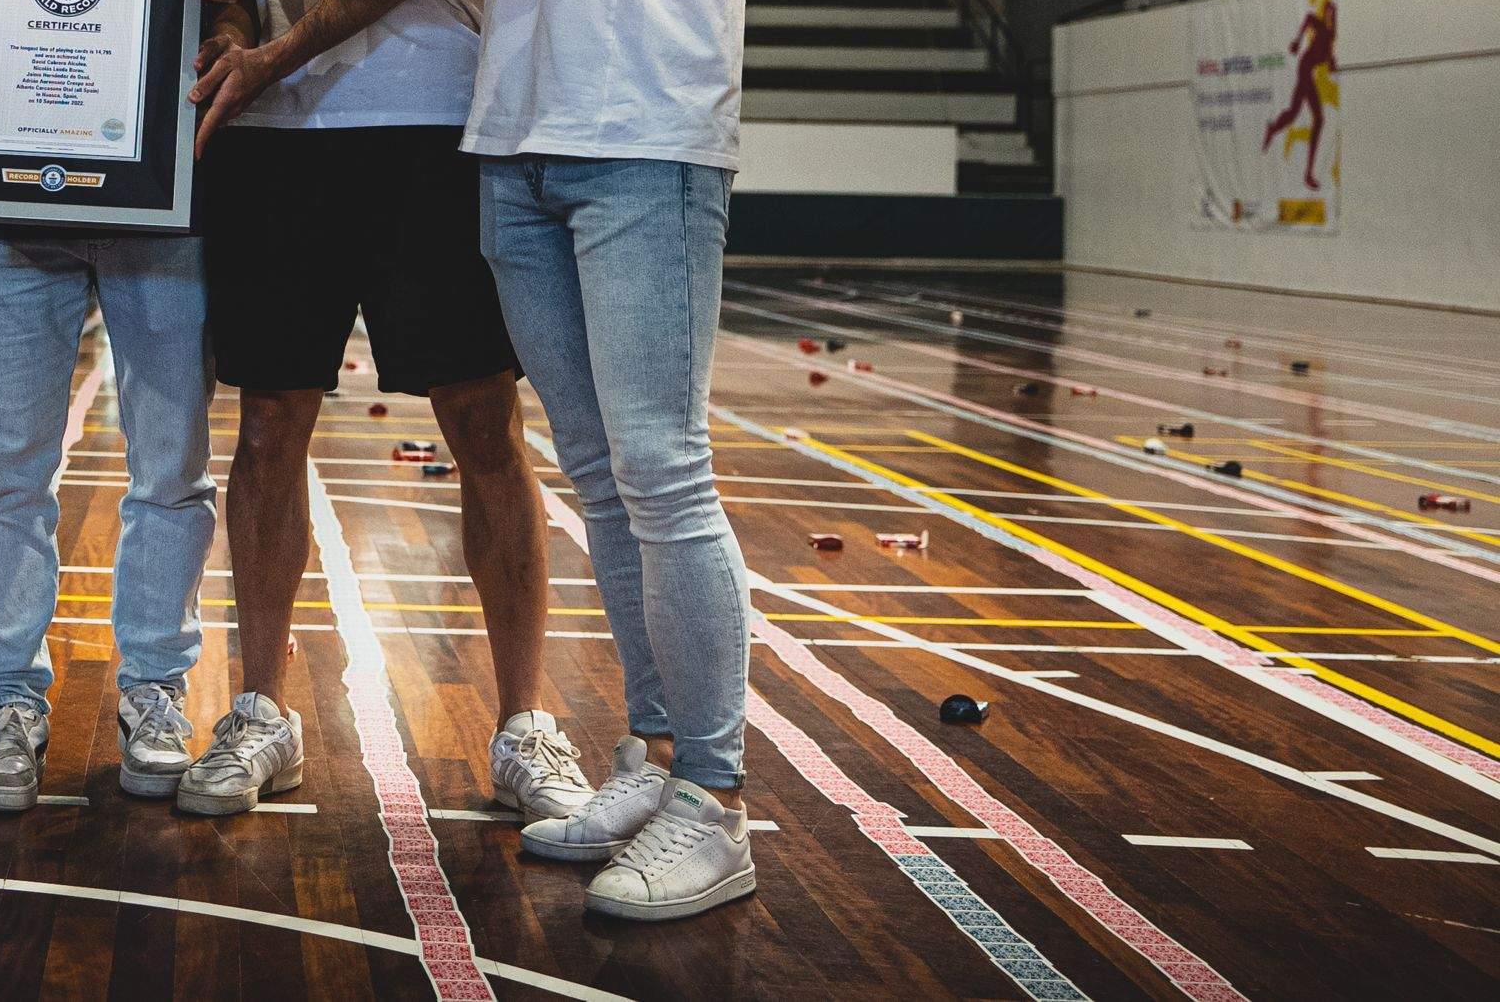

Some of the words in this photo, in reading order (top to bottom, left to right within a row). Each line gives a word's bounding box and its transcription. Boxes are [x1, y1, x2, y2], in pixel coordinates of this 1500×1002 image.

[28, 20, 101, 32] CERTIFICATE
[8, 173, 39, 181] RECORD
[67, 176, 97, 184] HOLDER
